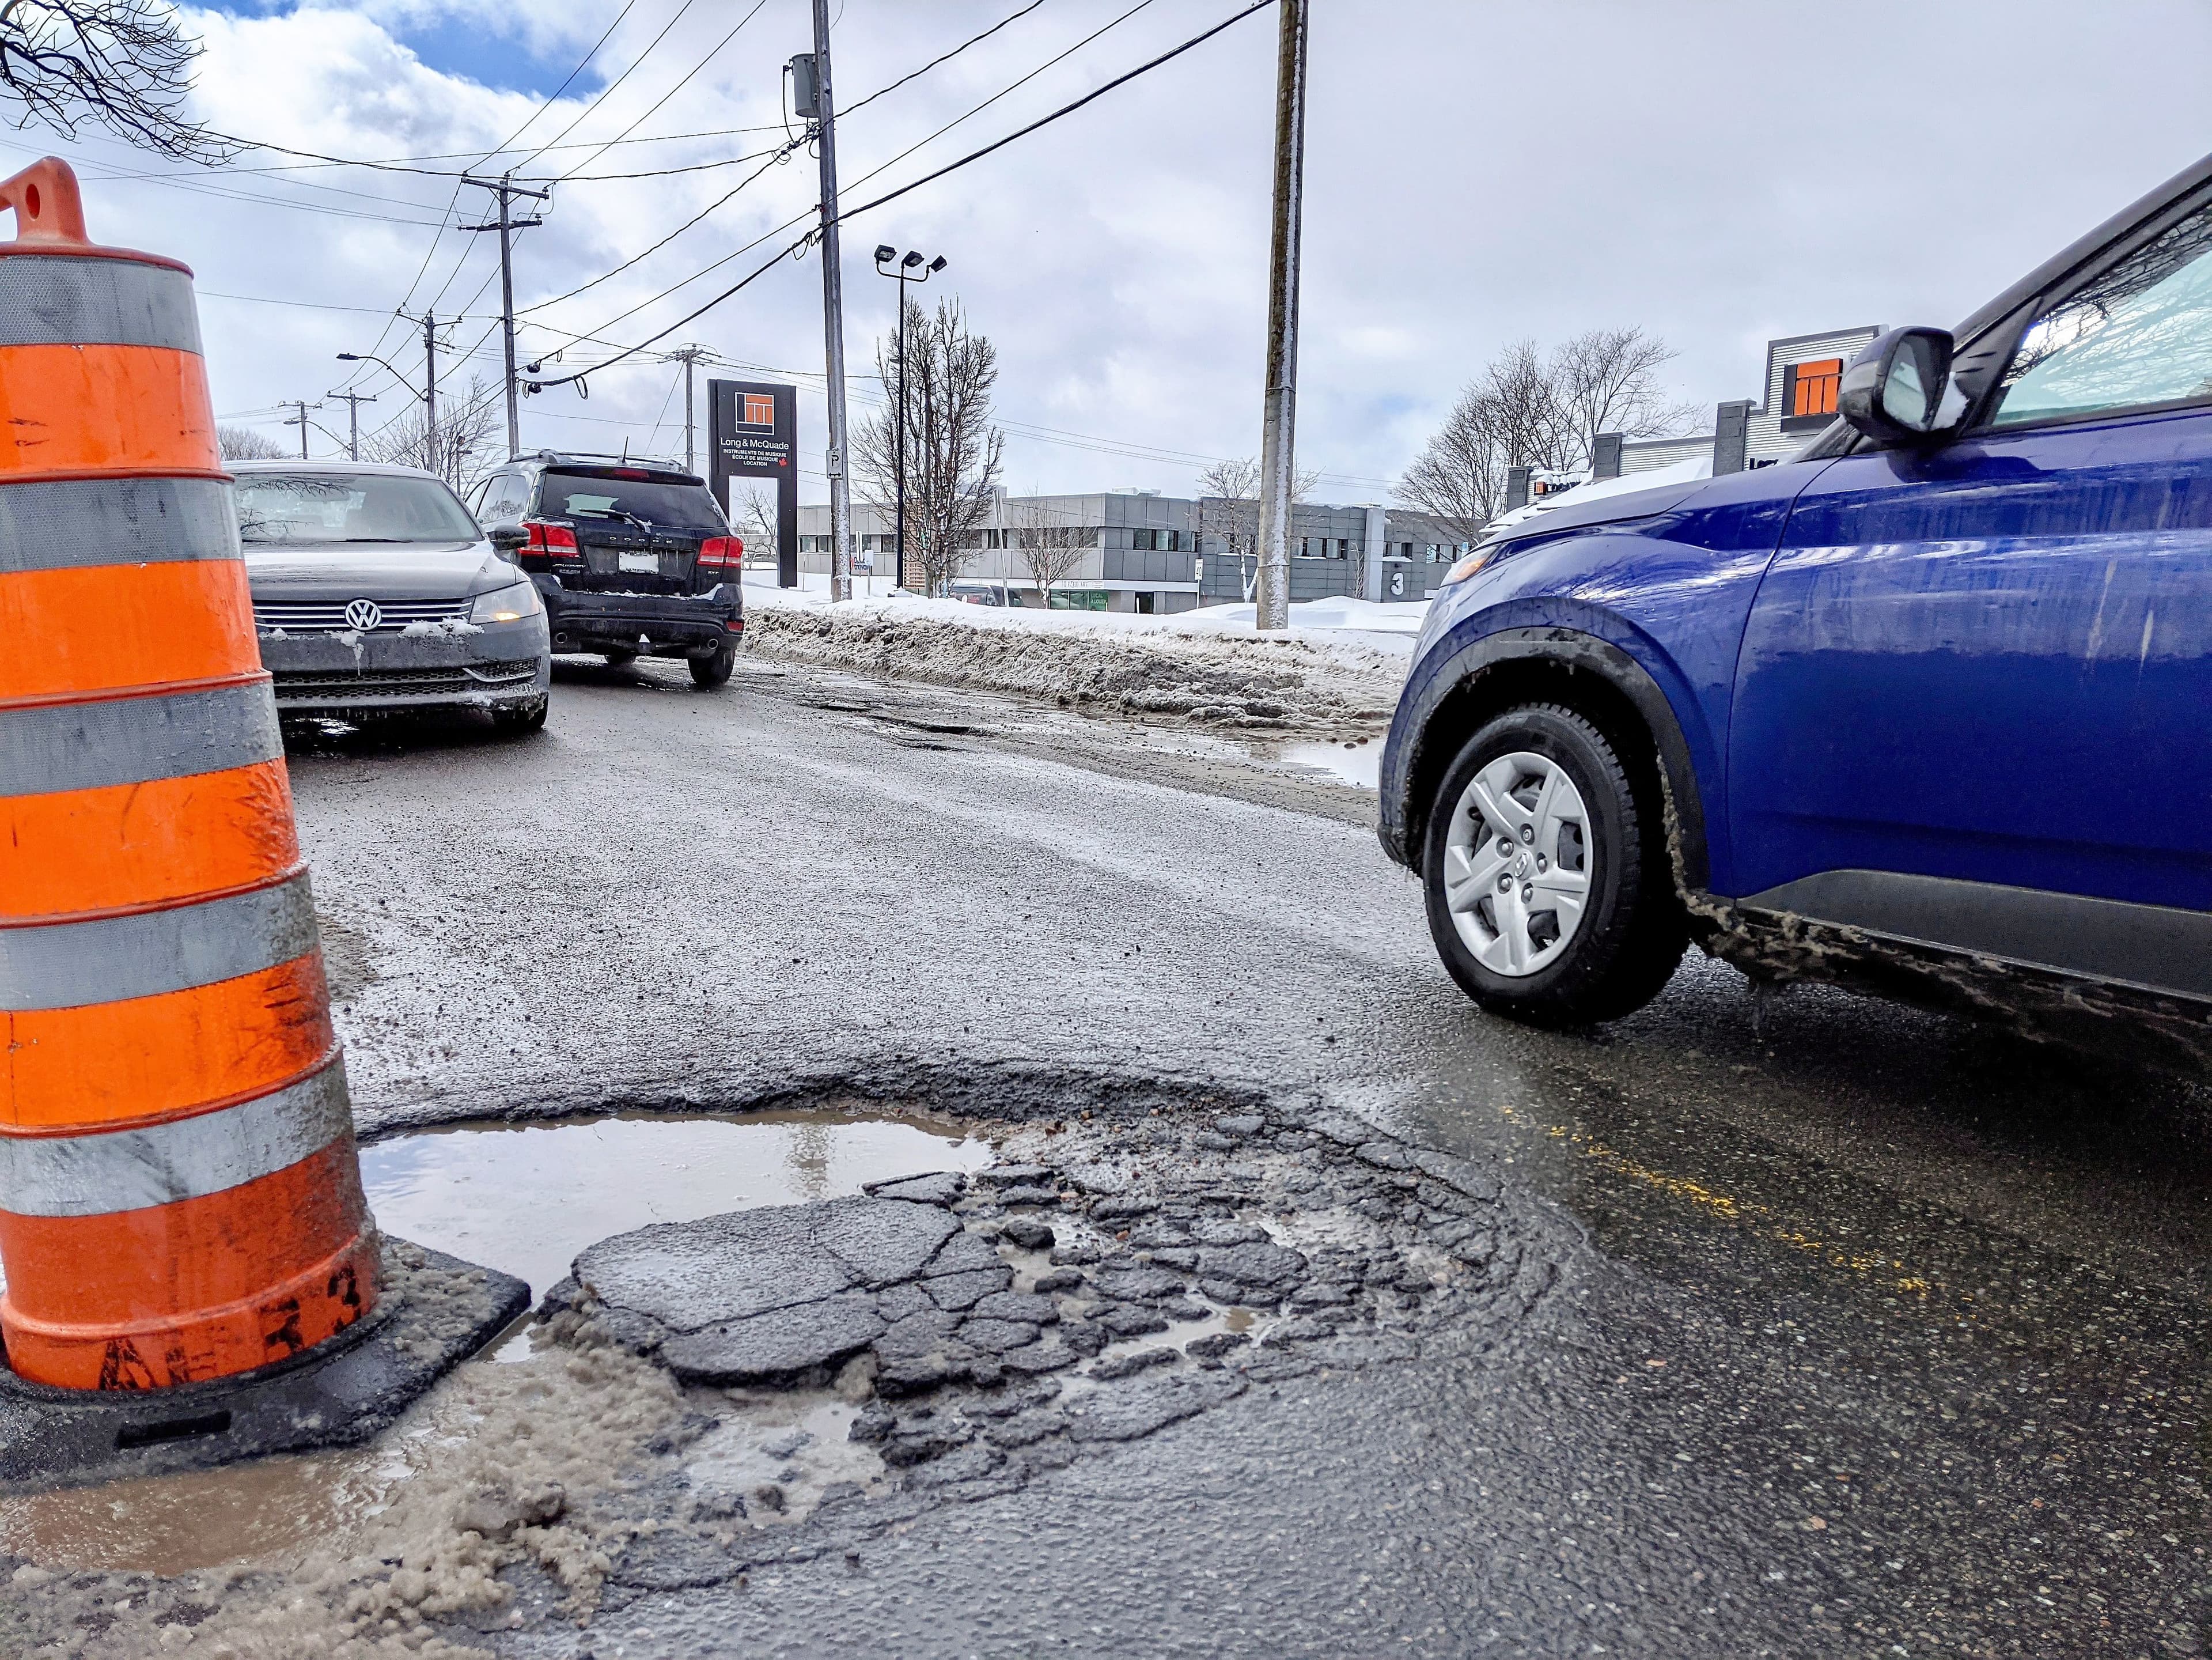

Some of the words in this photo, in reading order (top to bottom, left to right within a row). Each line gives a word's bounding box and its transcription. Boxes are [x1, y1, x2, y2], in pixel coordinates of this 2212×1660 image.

[720, 437, 741, 448] Long
[742, 438, 748, 447] &
[749, 439, 789, 450] McQuade
[1196, 566, 1202, 577] 40
[1391, 572, 1404, 595] 3
